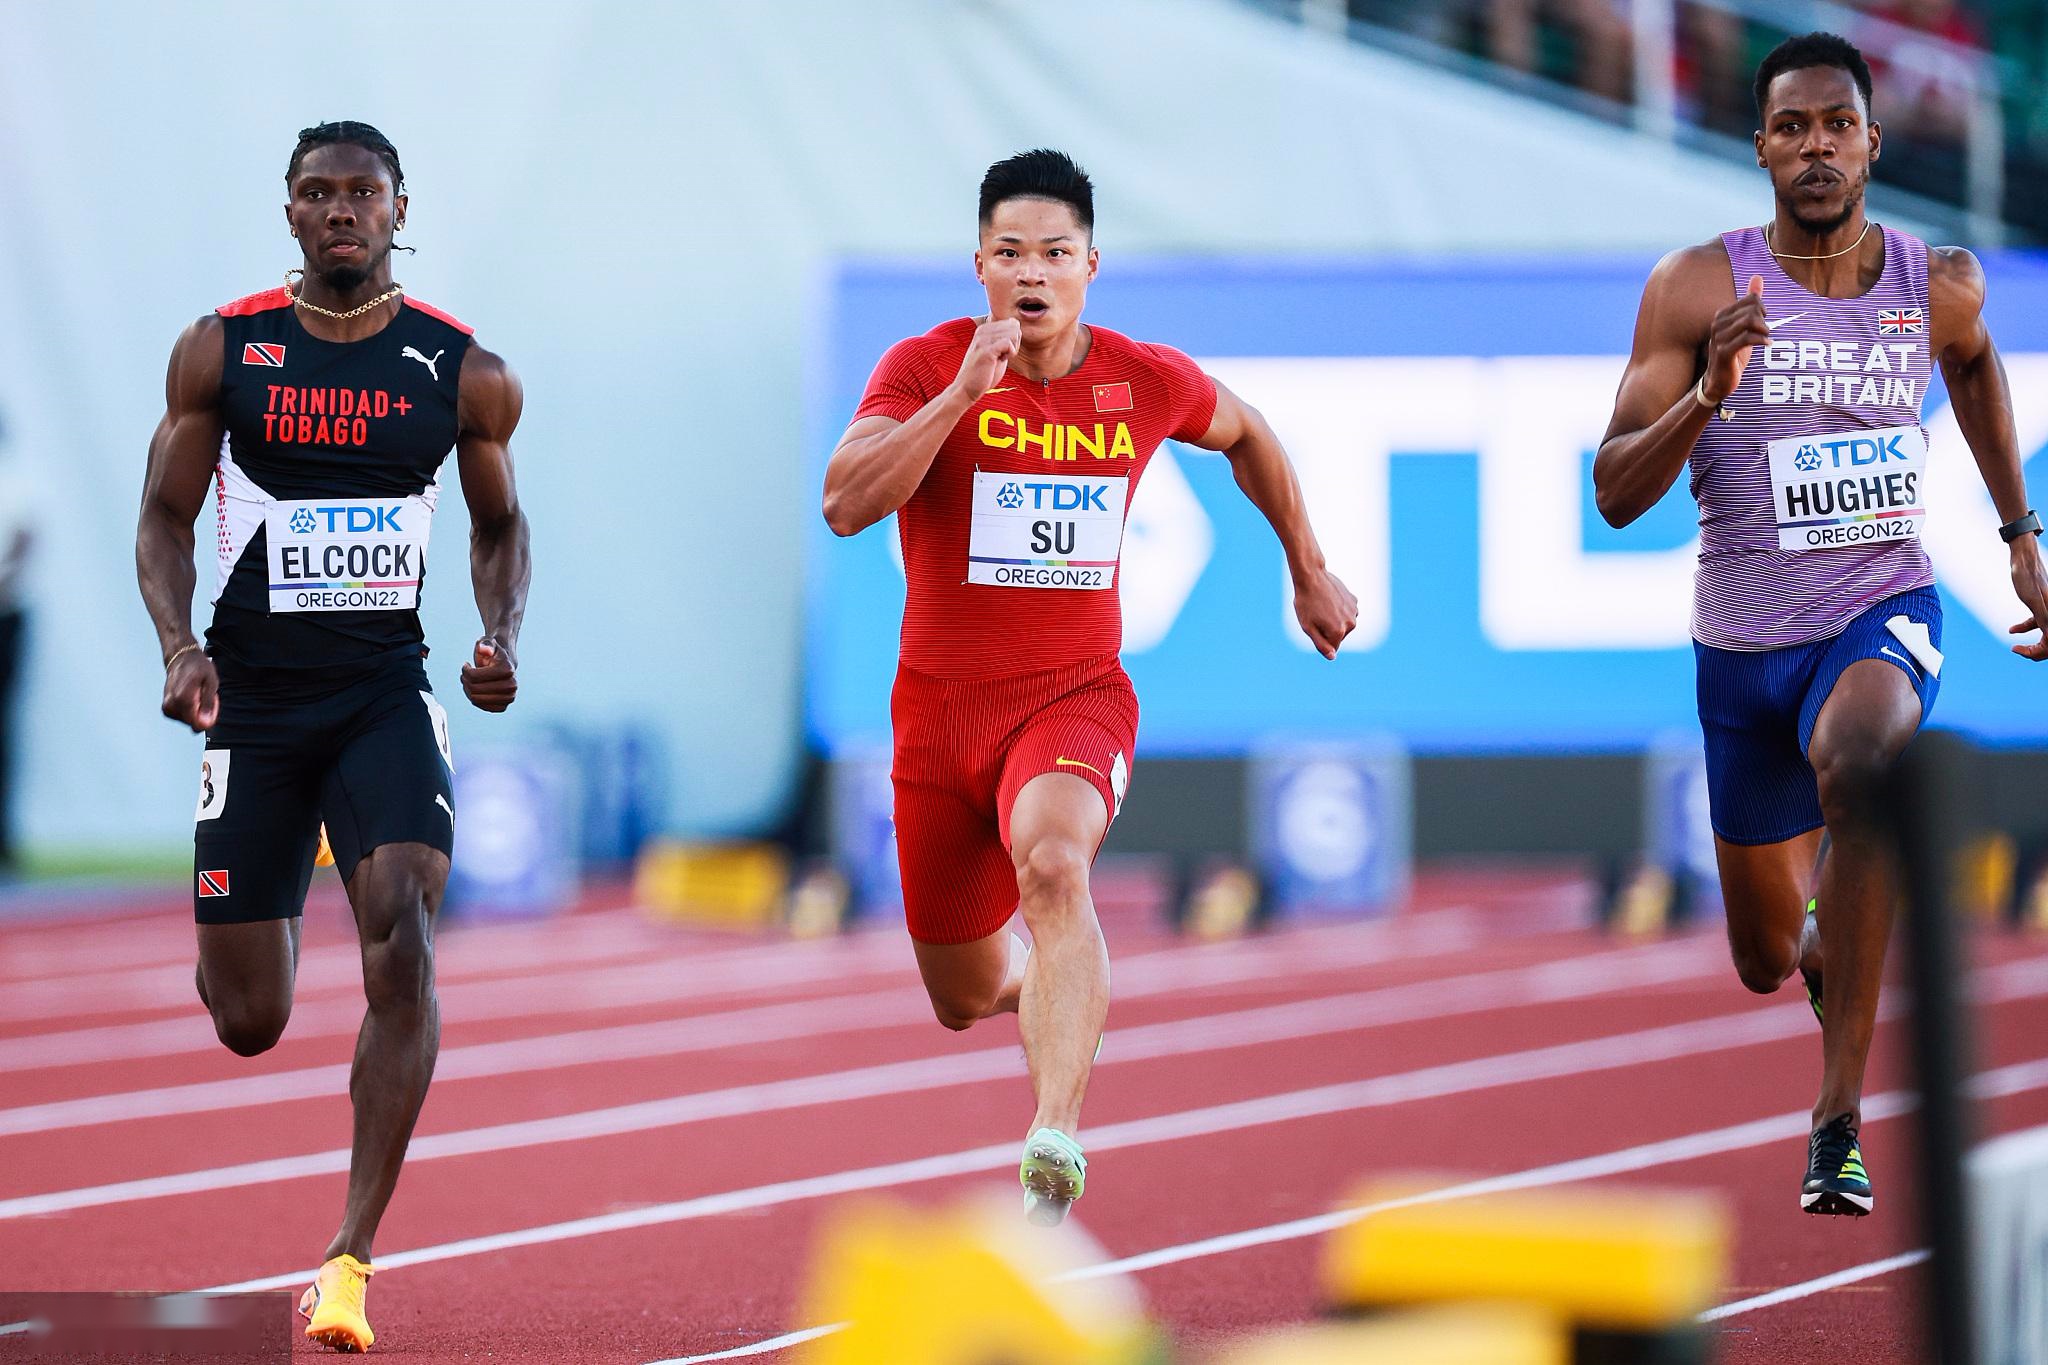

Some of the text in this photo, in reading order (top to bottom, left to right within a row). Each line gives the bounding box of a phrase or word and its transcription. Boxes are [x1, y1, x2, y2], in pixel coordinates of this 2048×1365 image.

[1763, 340, 1917, 373] GREAT
[1762, 375, 1915, 407] BRITAIN
[263, 413, 367, 446] TOBAGO
[978, 409, 1136, 461] CHINA
[1820, 435, 1908, 468] TDK
[1024, 483, 1109, 512] TDK
[1786, 472, 1917, 518] HUGHES
[316, 506, 403, 533] TDK
[1806, 519, 1915, 545] OREGON22
[1030, 520, 1075, 555] SU
[281, 544, 411, 579] ELCOCK
[995, 567, 1102, 586] OREGON22
[296, 591, 399, 608] OREGON22
